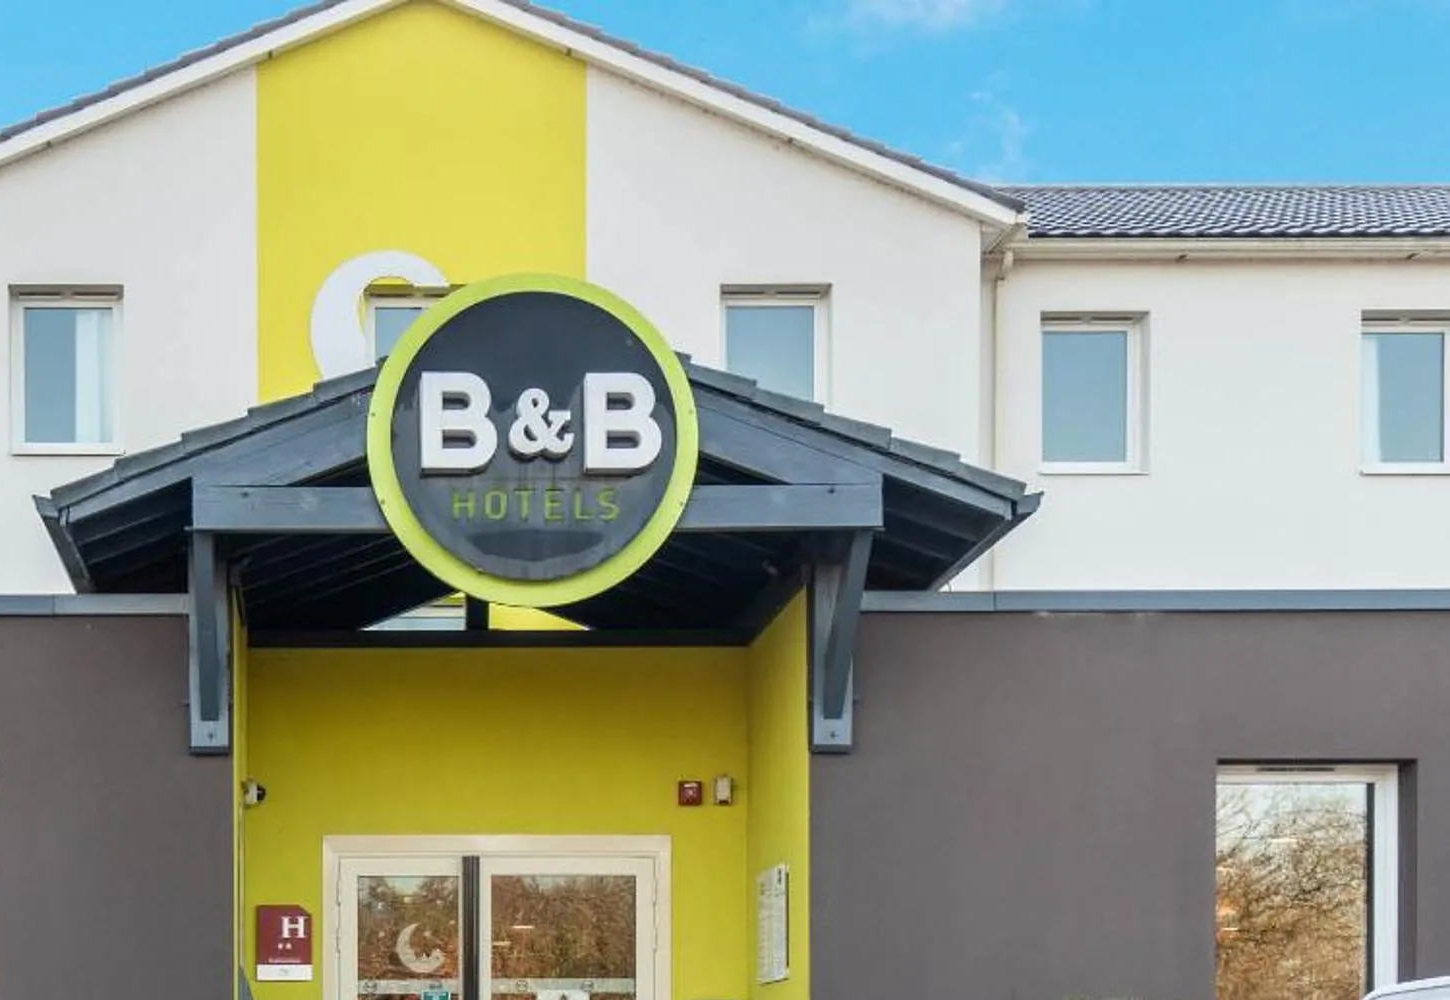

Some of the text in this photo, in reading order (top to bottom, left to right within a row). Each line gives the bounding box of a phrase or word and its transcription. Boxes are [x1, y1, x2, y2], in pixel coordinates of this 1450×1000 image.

[419, 371, 662, 474] B&B
[452, 488, 621, 521] HOTELS
[281, 915, 309, 939] H
